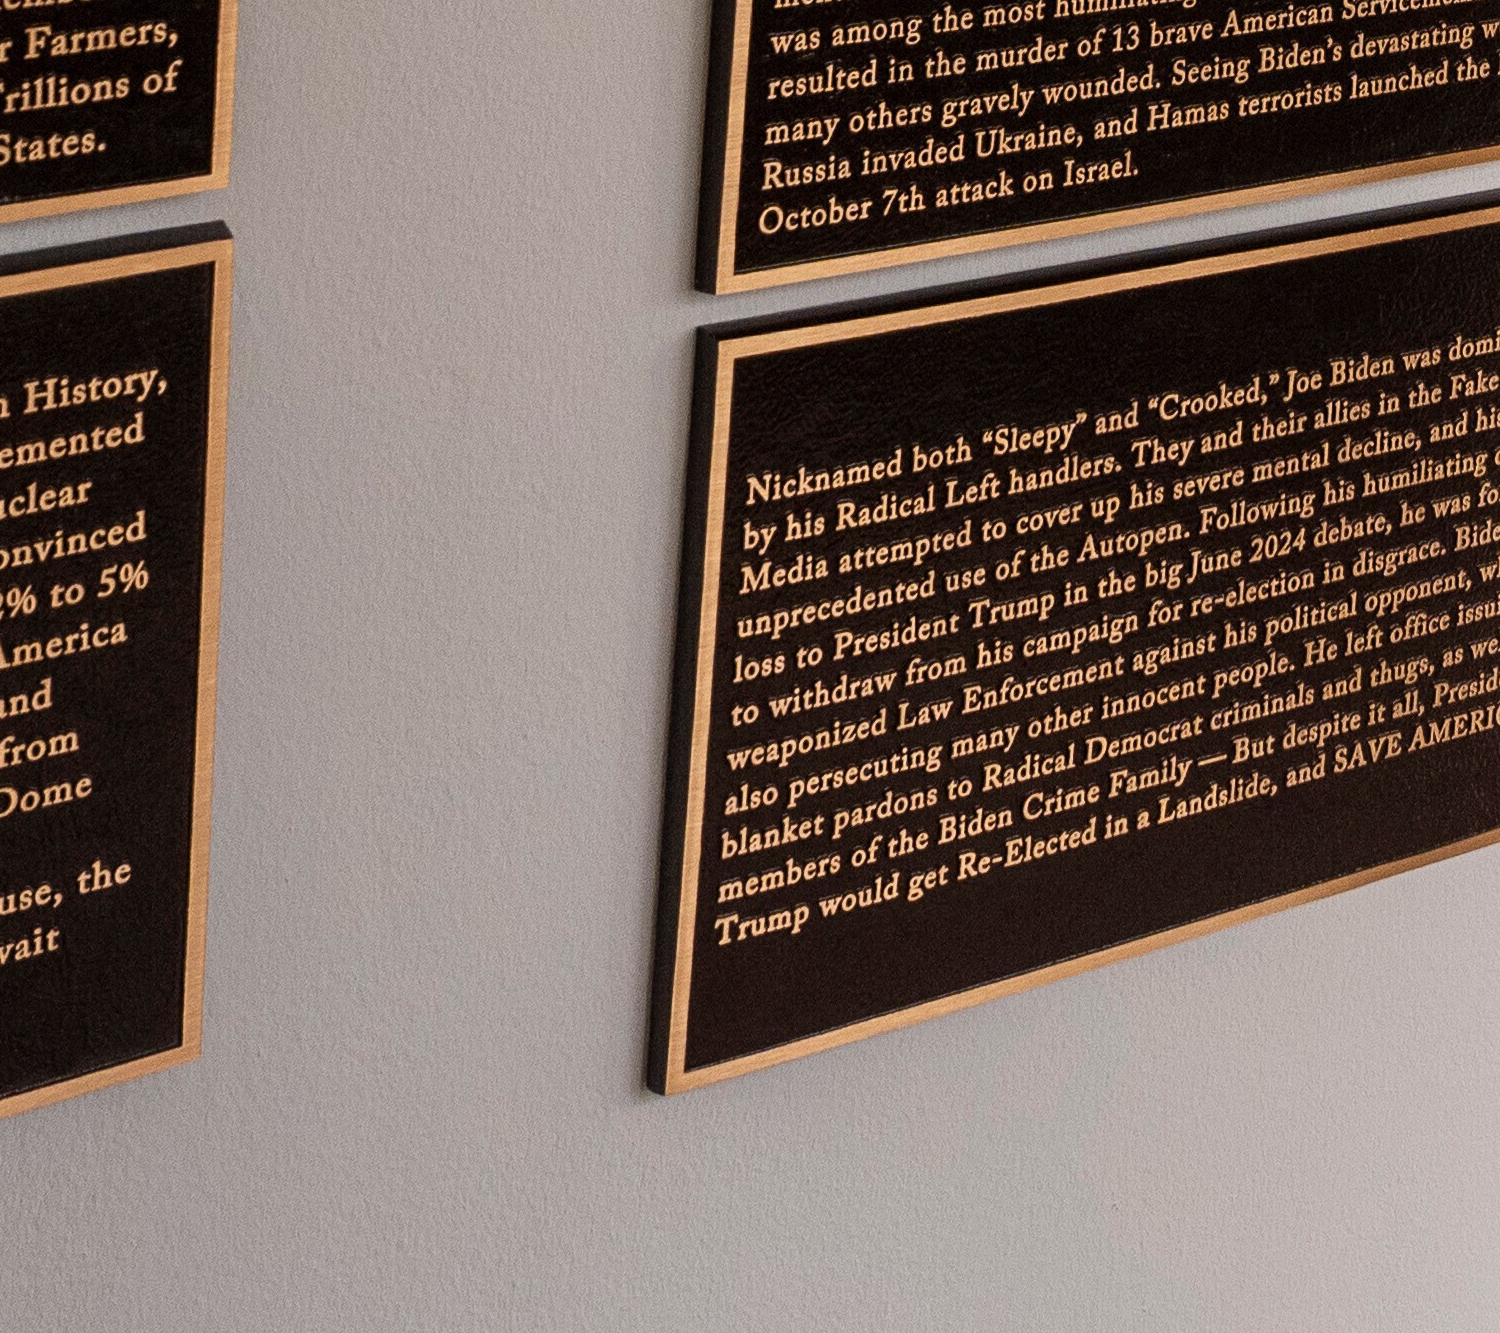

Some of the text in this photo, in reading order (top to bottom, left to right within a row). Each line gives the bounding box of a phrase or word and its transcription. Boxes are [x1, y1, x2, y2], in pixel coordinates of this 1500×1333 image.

[758, 150, 1139, 235] October 7th attack on Israel.
[746, 448, 902, 506] Nicknamed
[913, 436, 973, 473] both
[1095, 401, 1139, 435] and
[1283, 369, 1322, 402] Joe
[1329, 354, 1395, 387] Biden
[1402, 348, 1441, 371] was
[50, 582, 86, 609] to
[97, 559, 150, 599] 5%
[714, 905, 810, 946] Trump
[819, 871, 900, 917] would
[907, 865, 949, 902] get
[957, 816, 1097, 881] Re-Elected
[1104, 814, 1129, 840] in
[1137, 811, 1150, 830] a
[1157, 772, 1278, 824] Landslide,
[1286, 753, 1326, 787] and
[1334, 732, 1402, 773] SAVE
